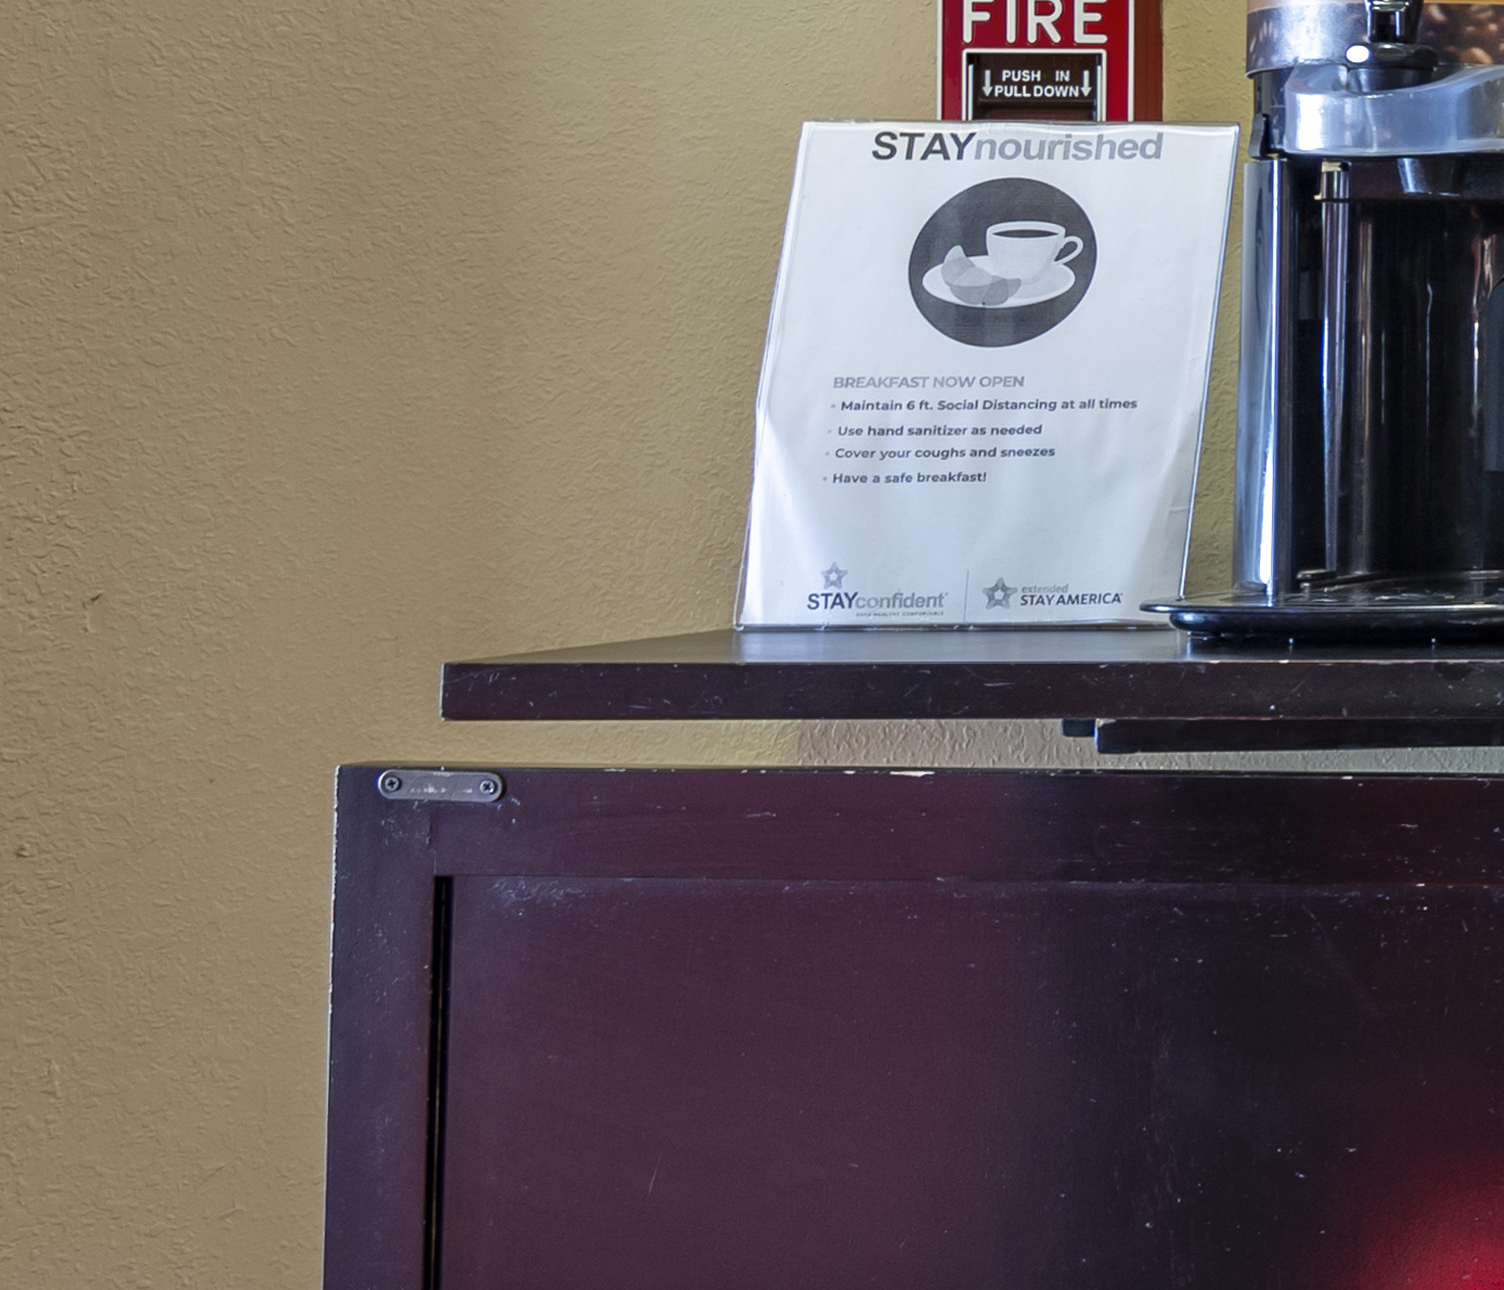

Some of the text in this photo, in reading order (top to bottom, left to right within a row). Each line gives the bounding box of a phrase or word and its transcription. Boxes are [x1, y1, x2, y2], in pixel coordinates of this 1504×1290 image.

[1002, 70, 1070, 82] PUSH IN
[994, 85, 1080, 97] PULL DOWN
[833, 375, 1025, 389] BREAKFAST NOW OPEN
[841, 398, 1138, 412] Maintain 6 ft. Social Distancing at all times
[838, 424, 1043, 437] Use hand sanitizer as needed
[835, 447, 1055, 462] Cover your coughs and sneezes
[832, 471, 987, 484] Have a safe breakfast!
[1021, 584, 1069, 594] extended
[1020, 592, 1122, 606] STAY AMERICA
